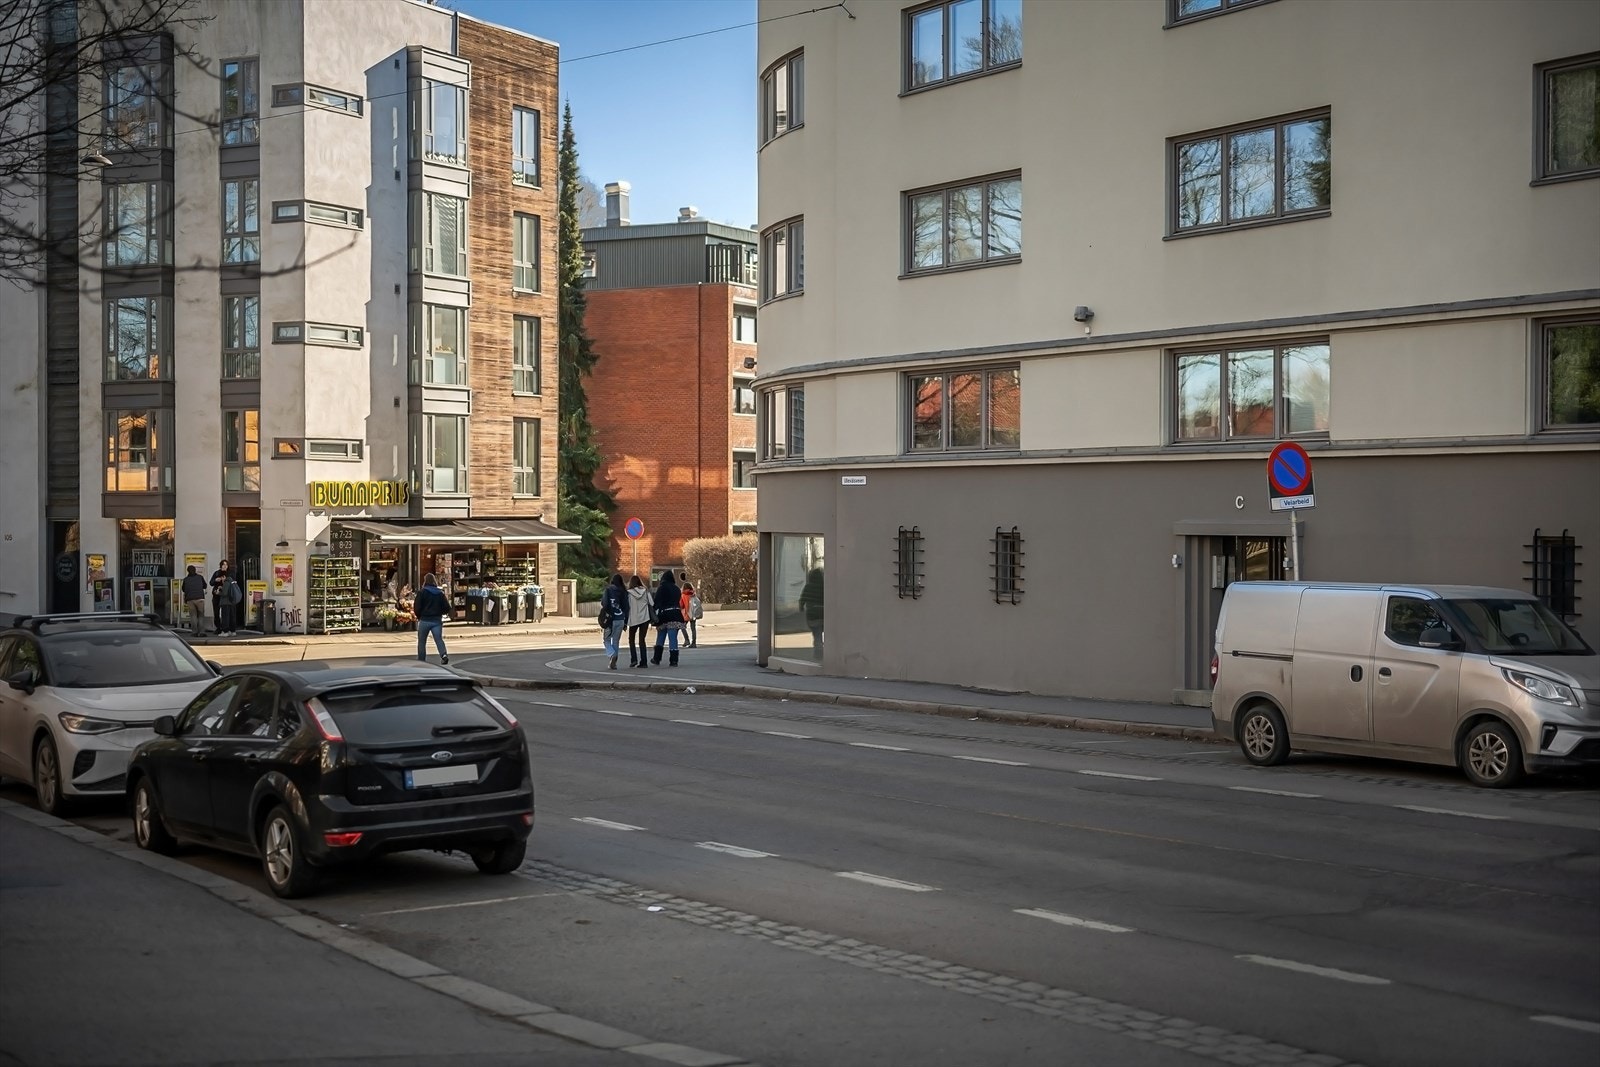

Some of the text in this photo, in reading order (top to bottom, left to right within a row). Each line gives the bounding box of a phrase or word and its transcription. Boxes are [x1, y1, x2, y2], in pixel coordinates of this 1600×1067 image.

[311, 481, 408, 507] BUNNPRIS
[1235, 495, 1244, 509] C
[1283, 498, 1310, 506] Veiarbeid
[134, 565, 159, 576] OVNEN
